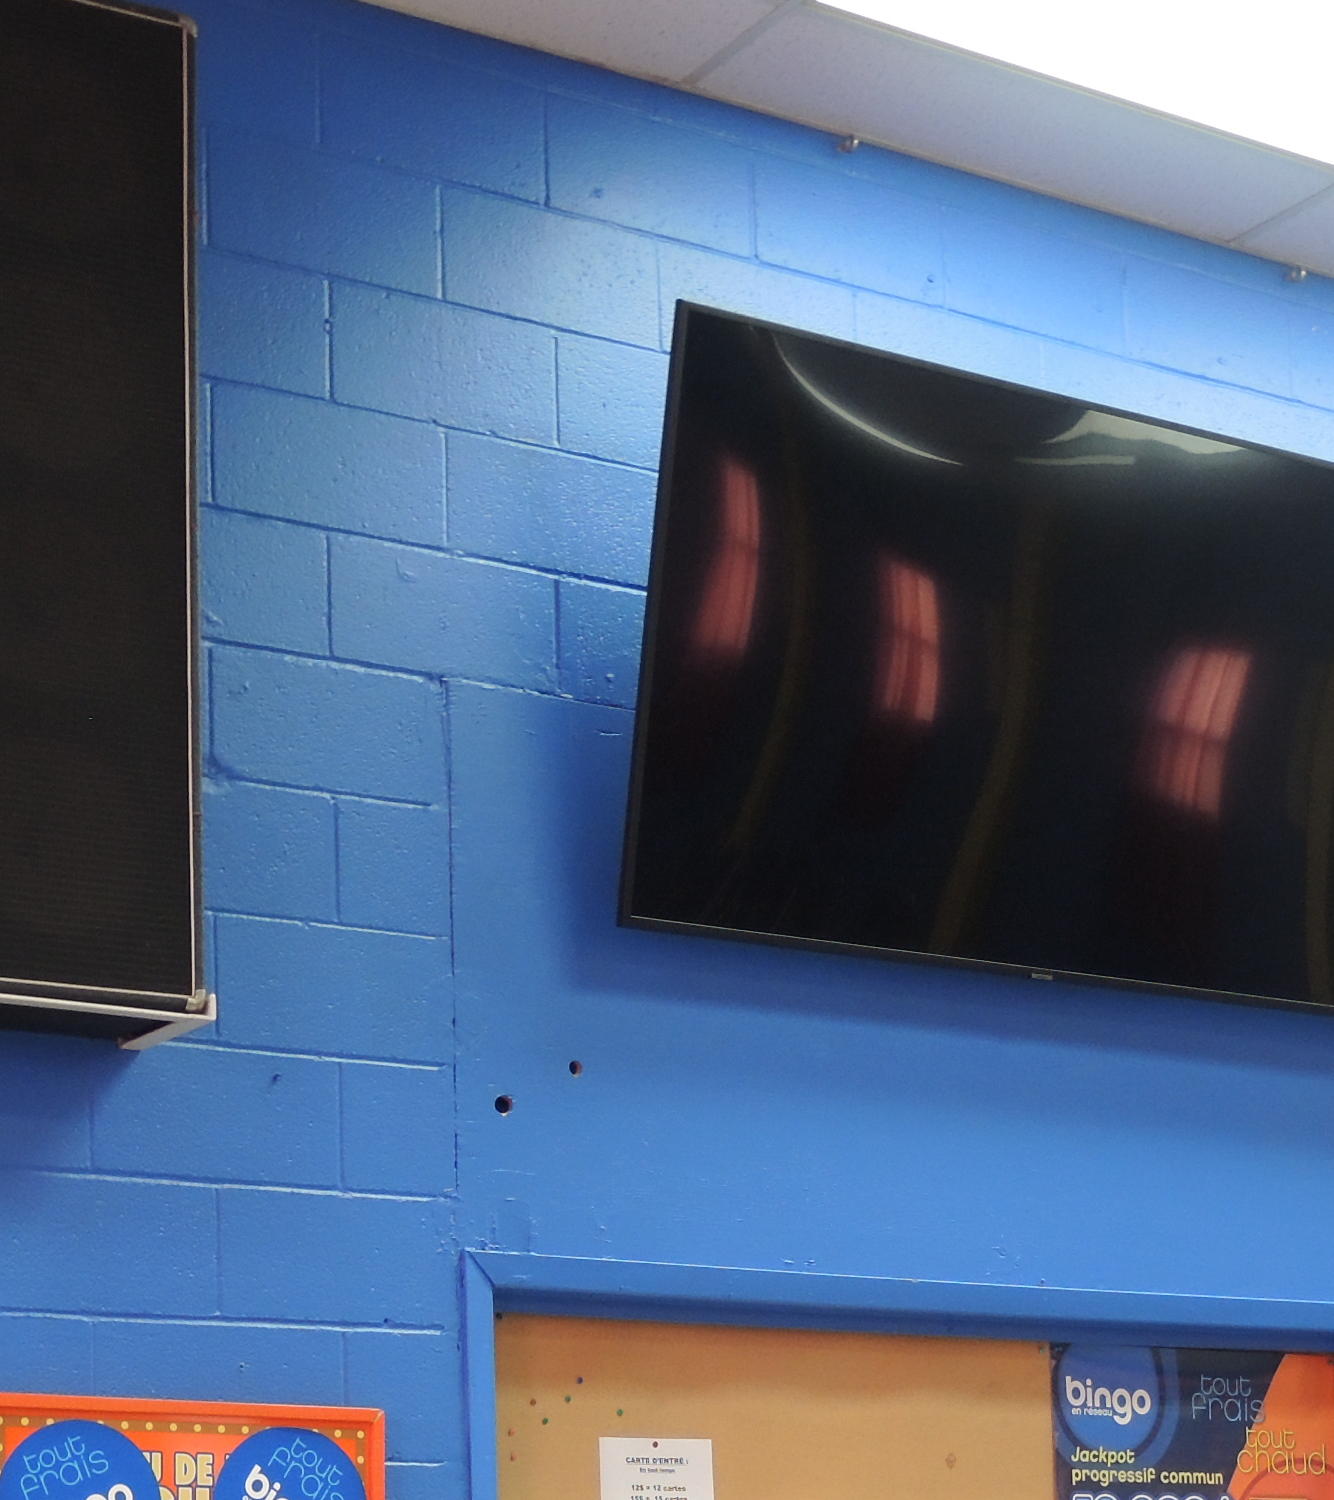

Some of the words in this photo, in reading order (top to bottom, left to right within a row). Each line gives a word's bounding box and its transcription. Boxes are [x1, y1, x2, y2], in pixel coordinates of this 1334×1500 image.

[1201, 1373, 1251, 1396] tout
[1066, 1376, 1151, 1425] bingo
[1072, 1408, 1082, 1416] en
[1084, 1407, 1112, 1417] réseau
[1192, 1393, 1265, 1422] frais
[1246, 1426, 1294, 1449] tout
[23, 1436, 85, 1473] tout
[174, 1451, 214, 1486] DE
[290, 1437, 343, 1485] tout
[1071, 1447, 1135, 1466] Jackpot
[1237, 1444, 1326, 1475] chaud
[1072, 1467, 1156, 1487] progressif
[1160, 1471, 1223, 1485] commun
